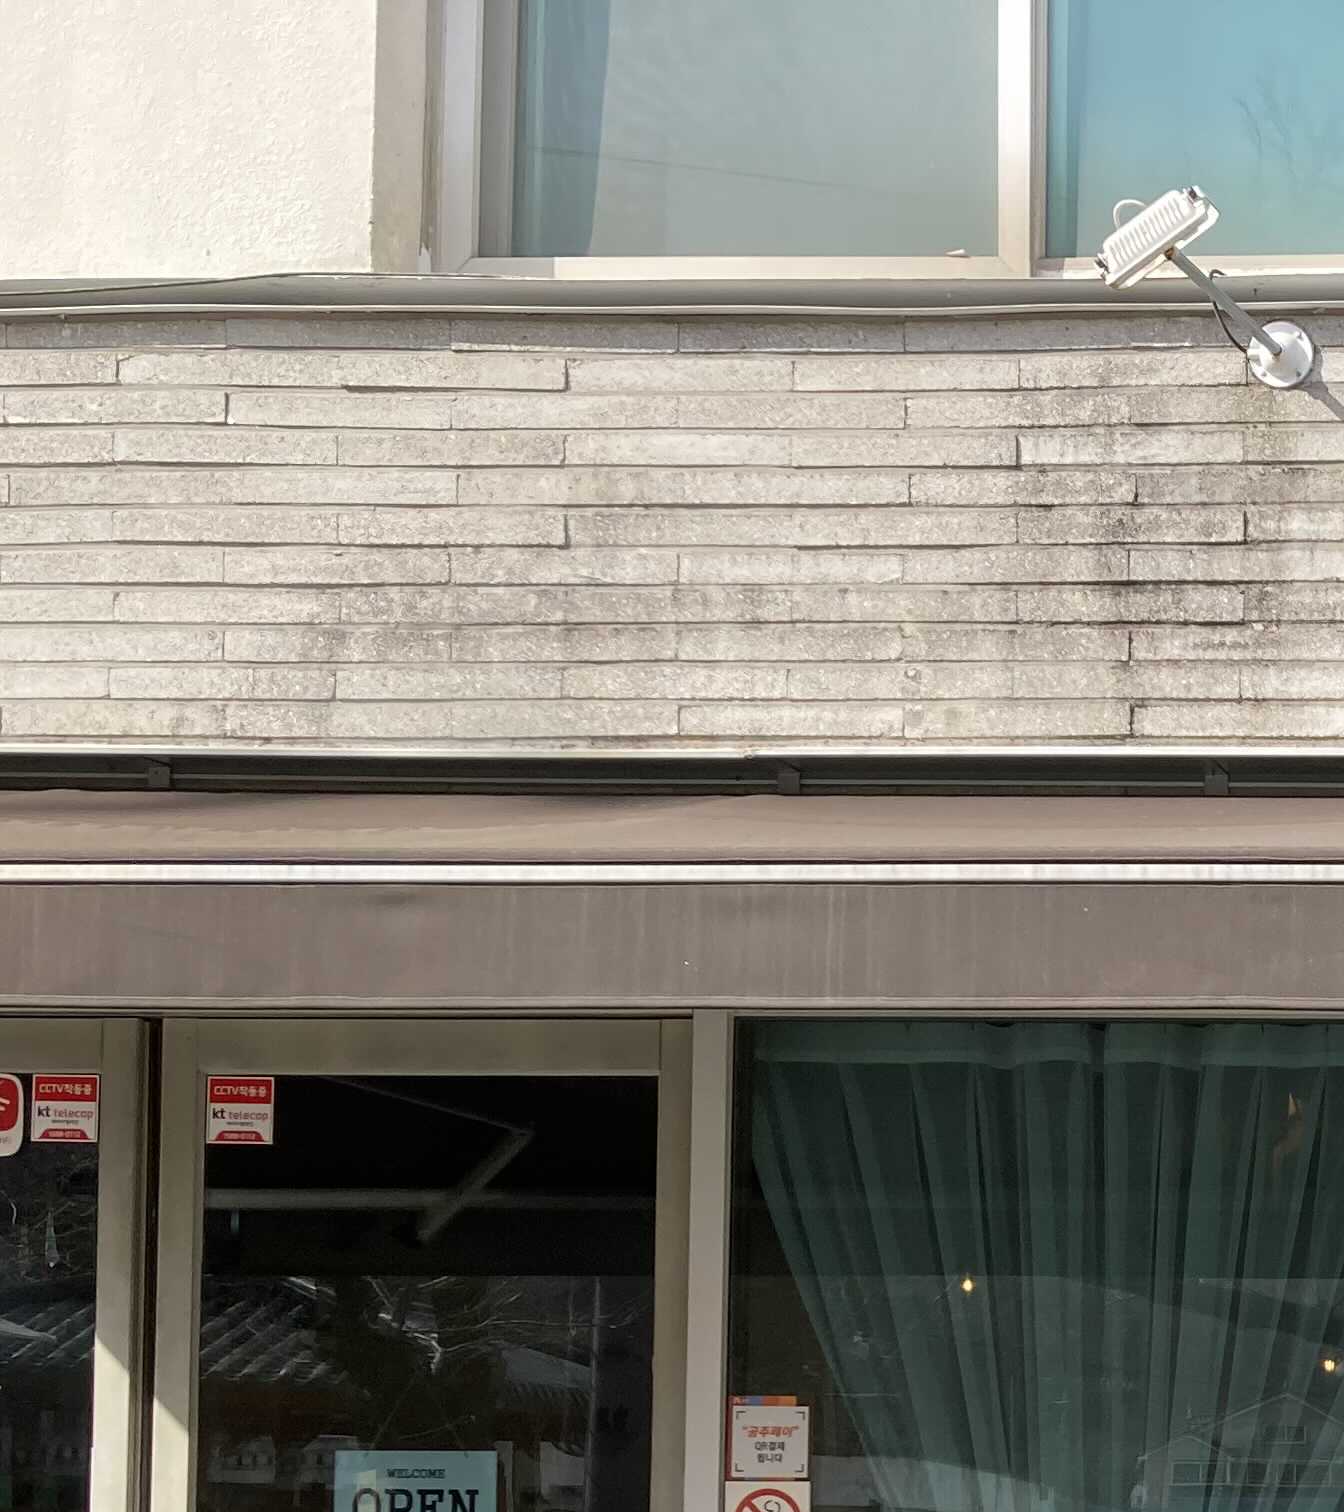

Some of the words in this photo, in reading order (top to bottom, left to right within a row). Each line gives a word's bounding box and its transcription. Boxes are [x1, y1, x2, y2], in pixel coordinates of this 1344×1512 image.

[38, 1083, 93, 1096] CCTV작동중
[213, 1085, 267, 1098] CCTV작동중
[37, 1105, 51, 1118] kt
[54, 1107, 94, 1121] telecop
[212, 1107, 226, 1120] kt
[228, 1109, 269, 1123] telecop
[386, 1468, 446, 1479] WELCOME
